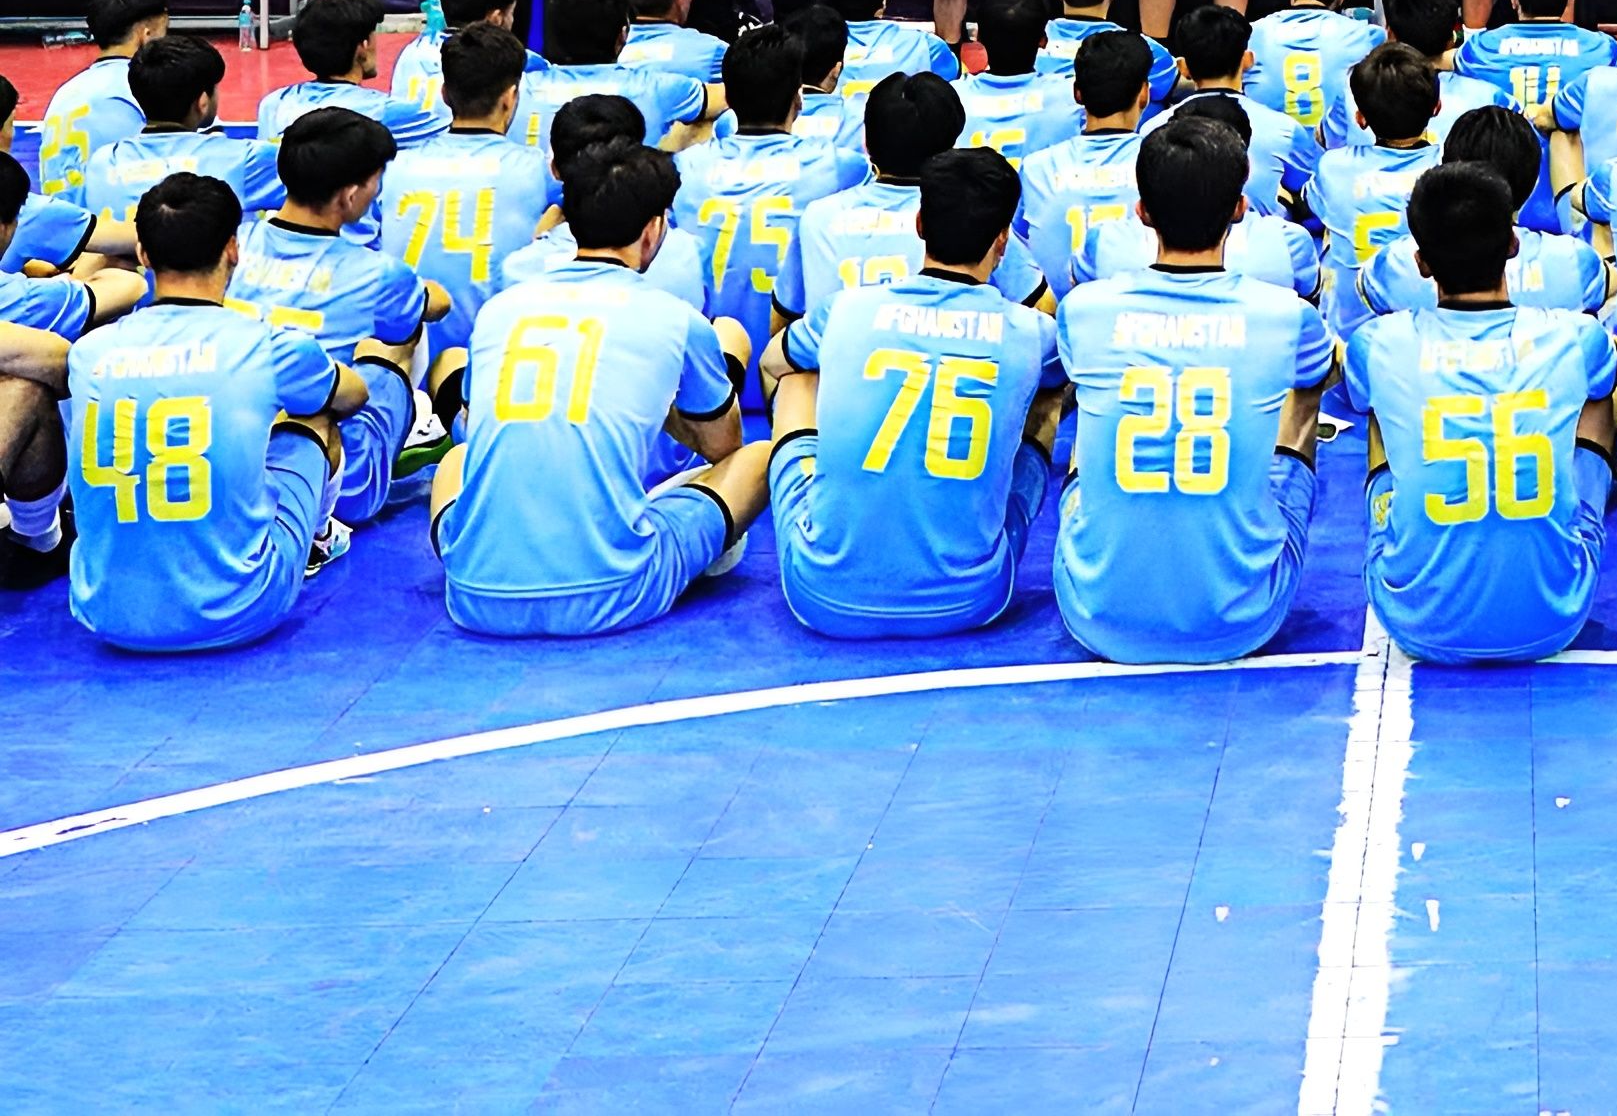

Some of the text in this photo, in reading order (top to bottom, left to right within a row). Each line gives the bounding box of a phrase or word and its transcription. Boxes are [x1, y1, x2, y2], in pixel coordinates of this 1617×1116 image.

[1283, 49, 1325, 127] 8
[396, 186, 496, 284] 74
[698, 195, 795, 294] 75
[494, 313, 606, 425] 61
[873, 303, 1004, 343] AFGHANISTAN
[80, 395, 213, 524] 48
[861, 347, 999, 481] 76
[1115, 365, 1232, 496] 28
[1421, 389, 1556, 526] 56
